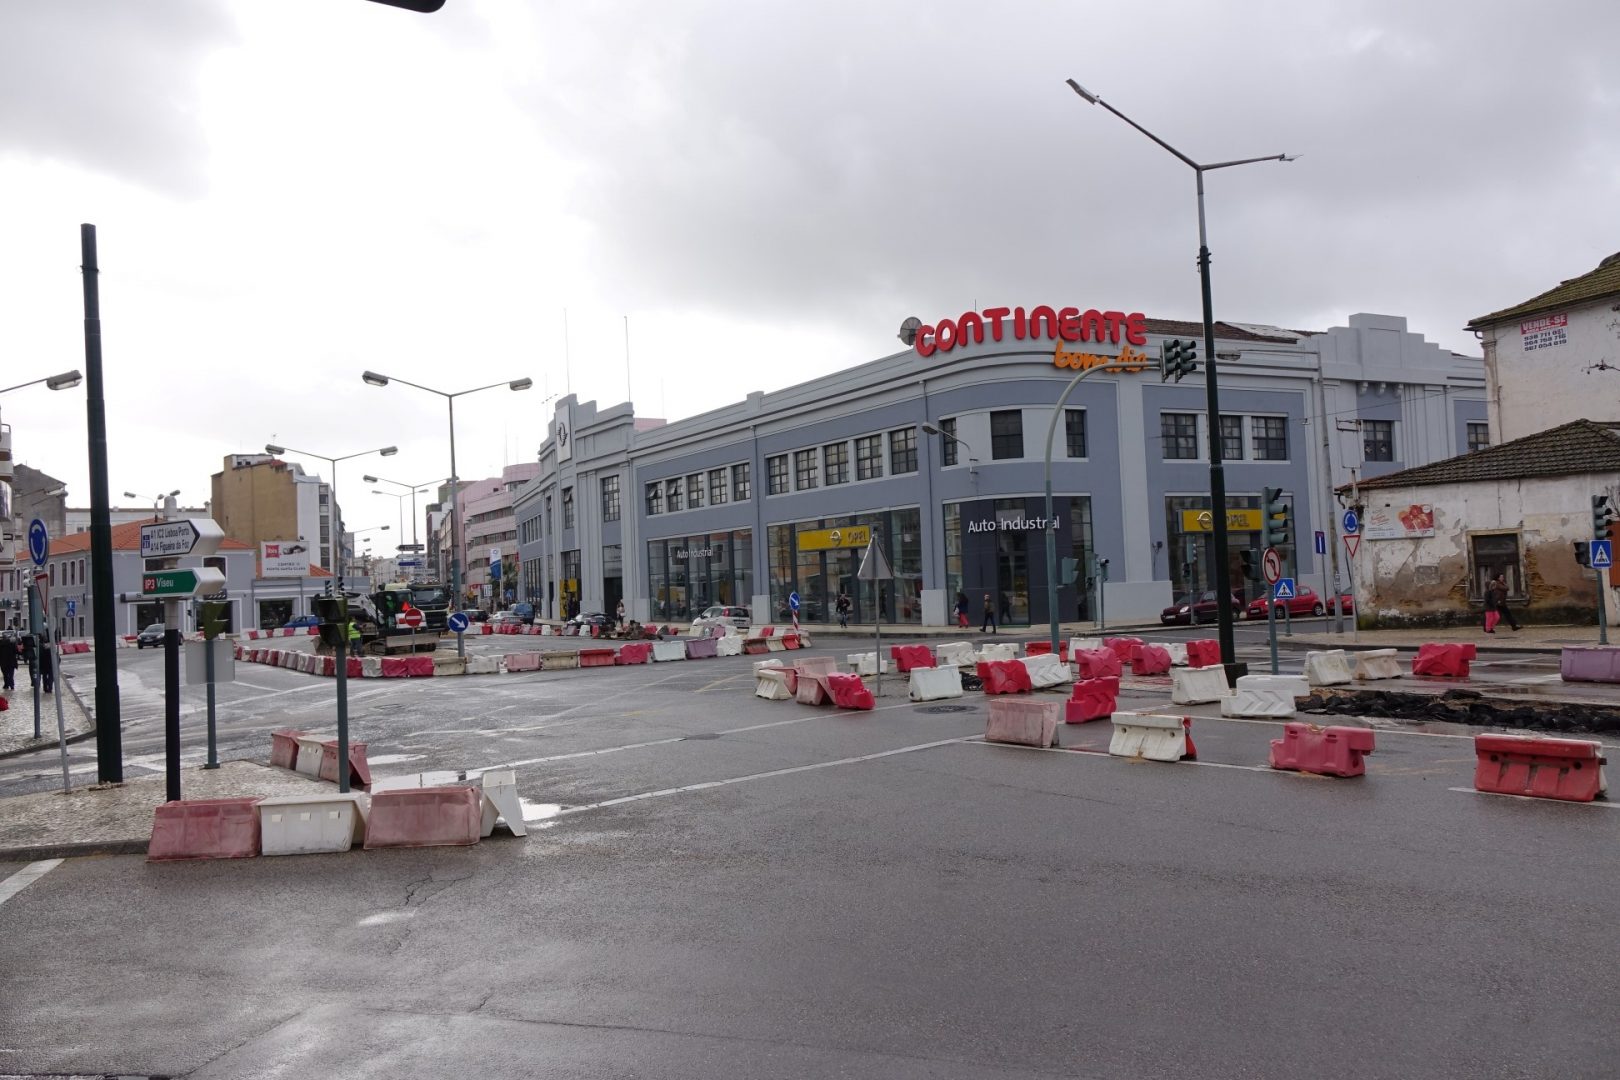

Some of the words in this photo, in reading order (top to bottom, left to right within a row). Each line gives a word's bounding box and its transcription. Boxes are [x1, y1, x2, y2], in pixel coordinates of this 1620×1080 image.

[1522, 315, 1566, 330] VENDE-SE
[915, 305, 1147, 357] CONTINENTE
[967, 519, 996, 533] Auto
[1001, 516, 1060, 530] Industral
[165, 527, 178, 538] Lisboa
[178, 526, 190, 537] Porto
[160, 541, 176, 553] Figueira
[182, 540, 190, 549] Foz
[677, 549, 689, 559] Auto
[144, 578, 155, 590] IP3
[156, 577, 174, 588] Viseu
